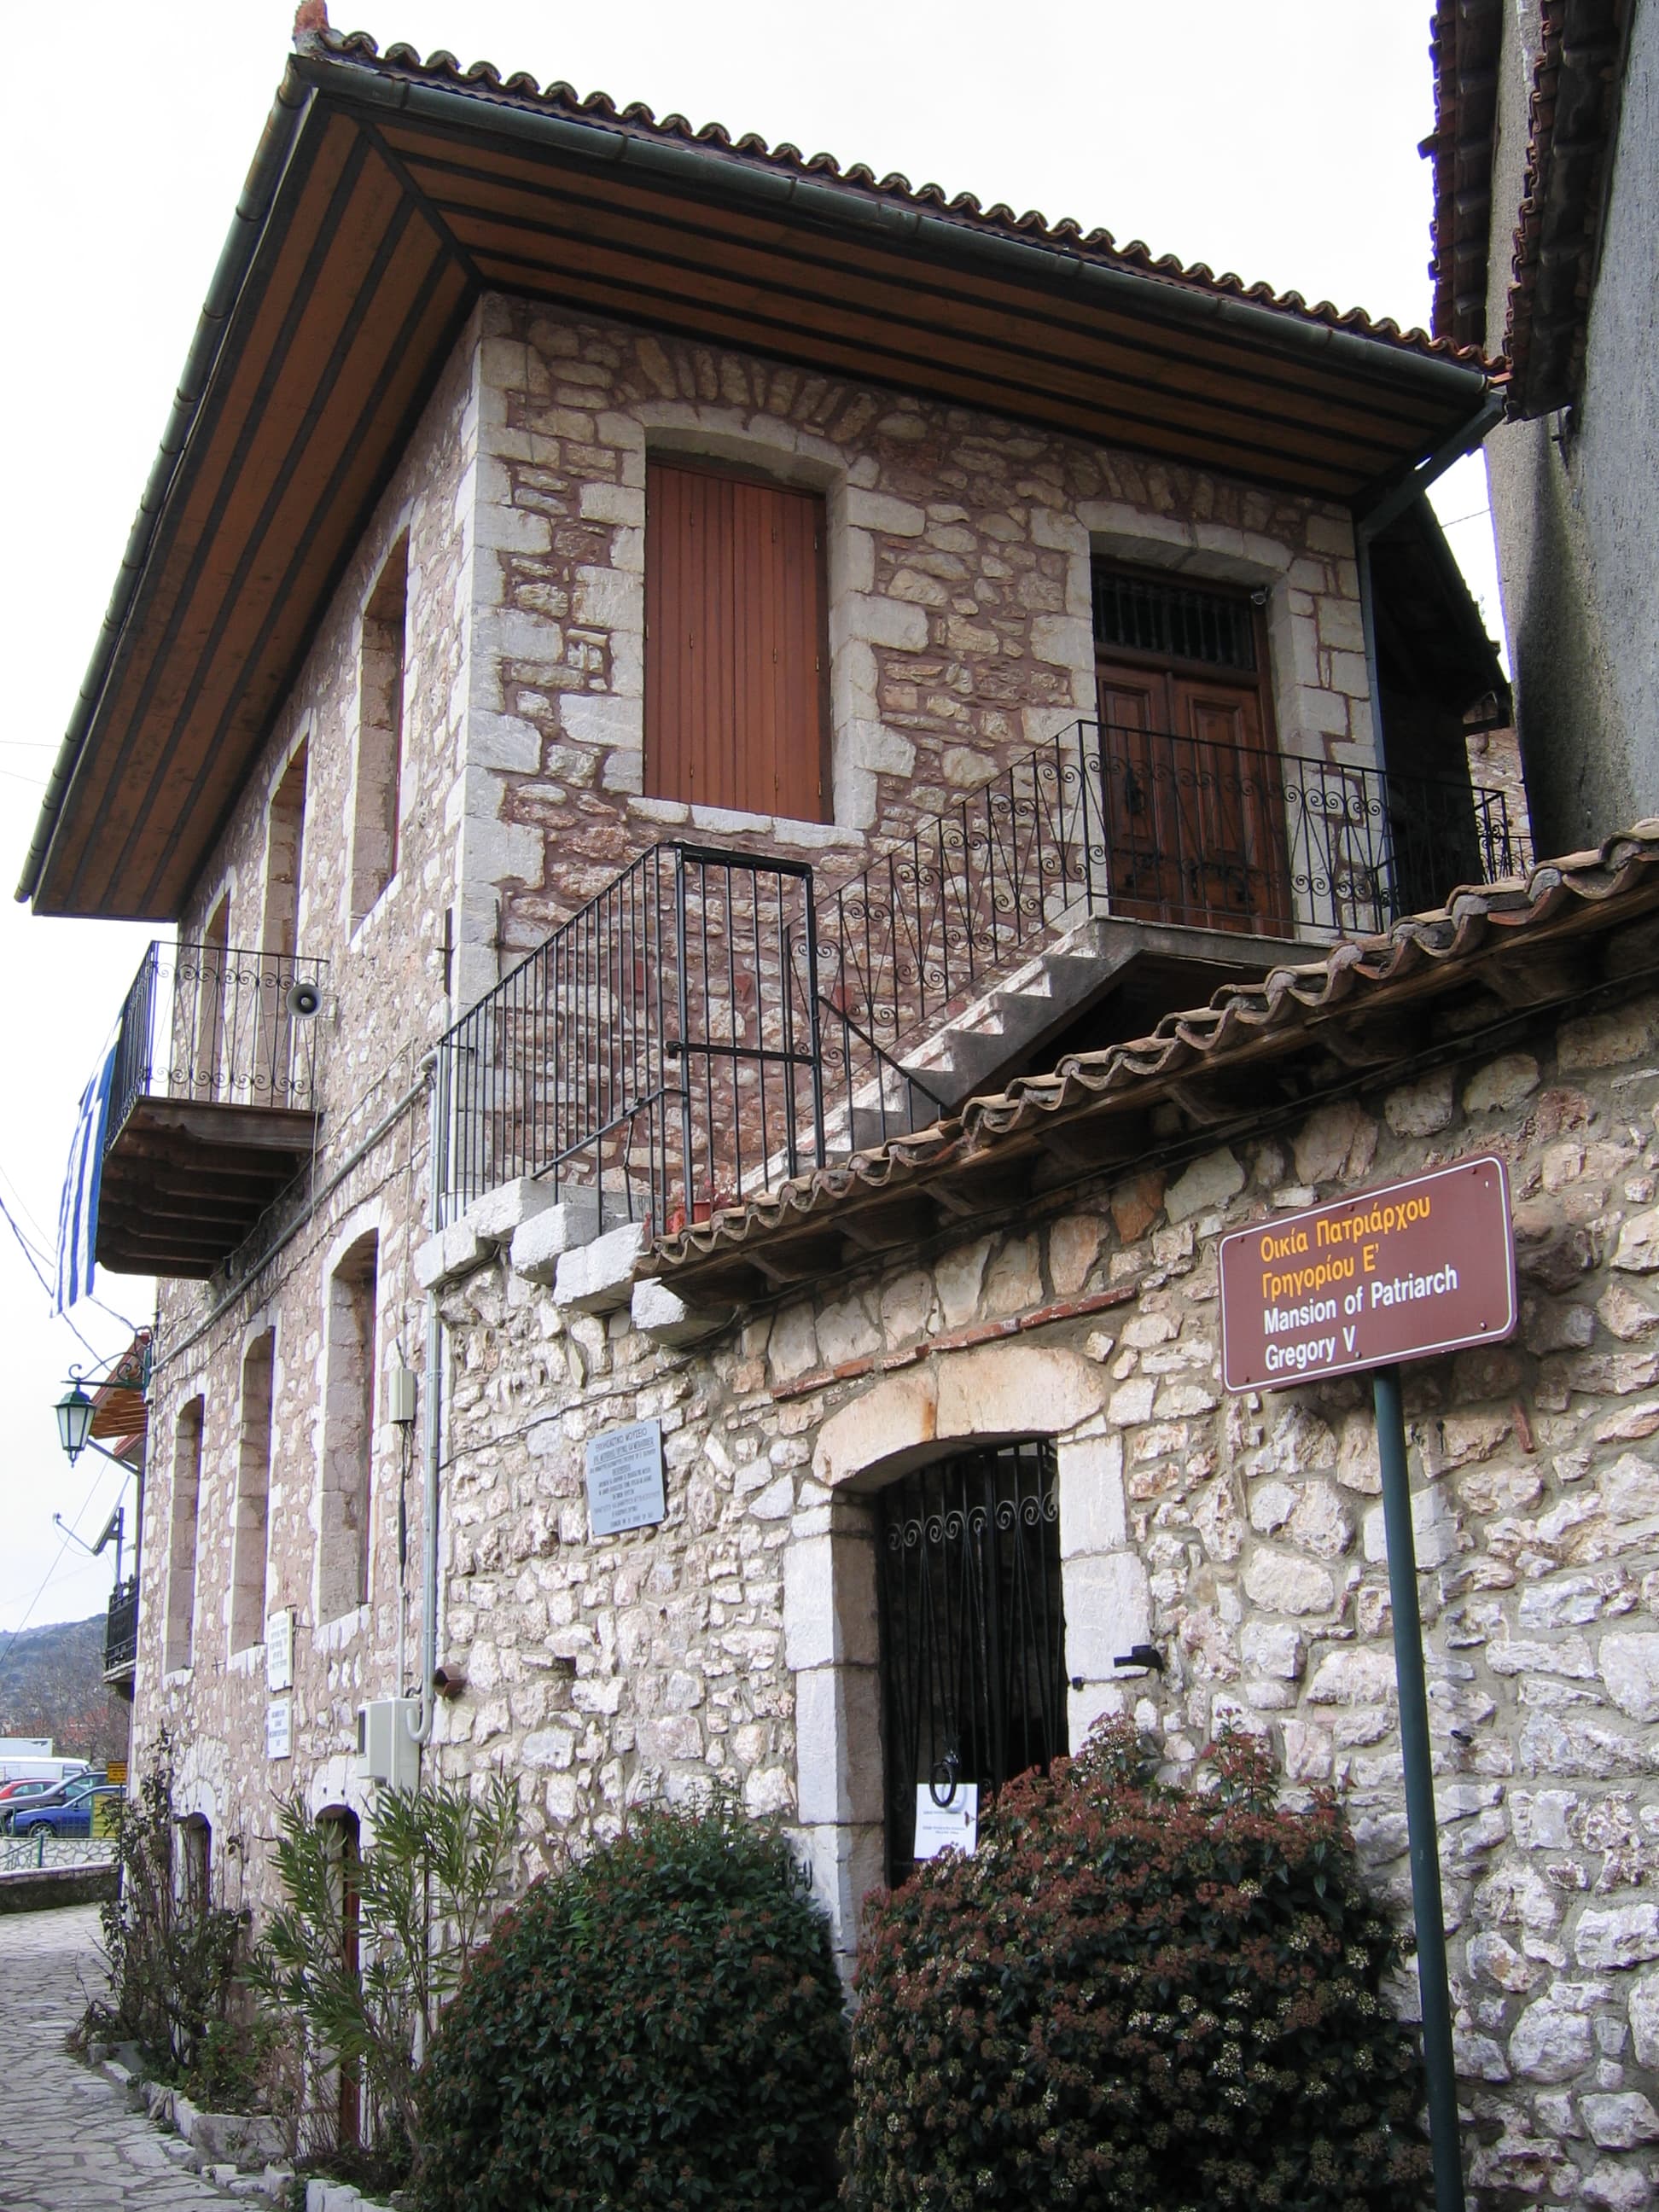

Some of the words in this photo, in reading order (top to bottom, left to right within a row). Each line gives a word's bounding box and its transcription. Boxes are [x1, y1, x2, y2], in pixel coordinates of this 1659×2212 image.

[1260, 1228, 1308, 1262] Οικία
[1316, 1196, 1430, 1247] Πατριάρχου
[1262, 1256, 1354, 1301] Γρηγορίου
[1264, 1298, 1336, 1335] Mansion
[1344, 1286, 1363, 1315] of
[1371, 1264, 1458, 1309] Patriarch
[1265, 1336, 1336, 1371] Gregory
[1342, 1325, 1356, 1353] V
